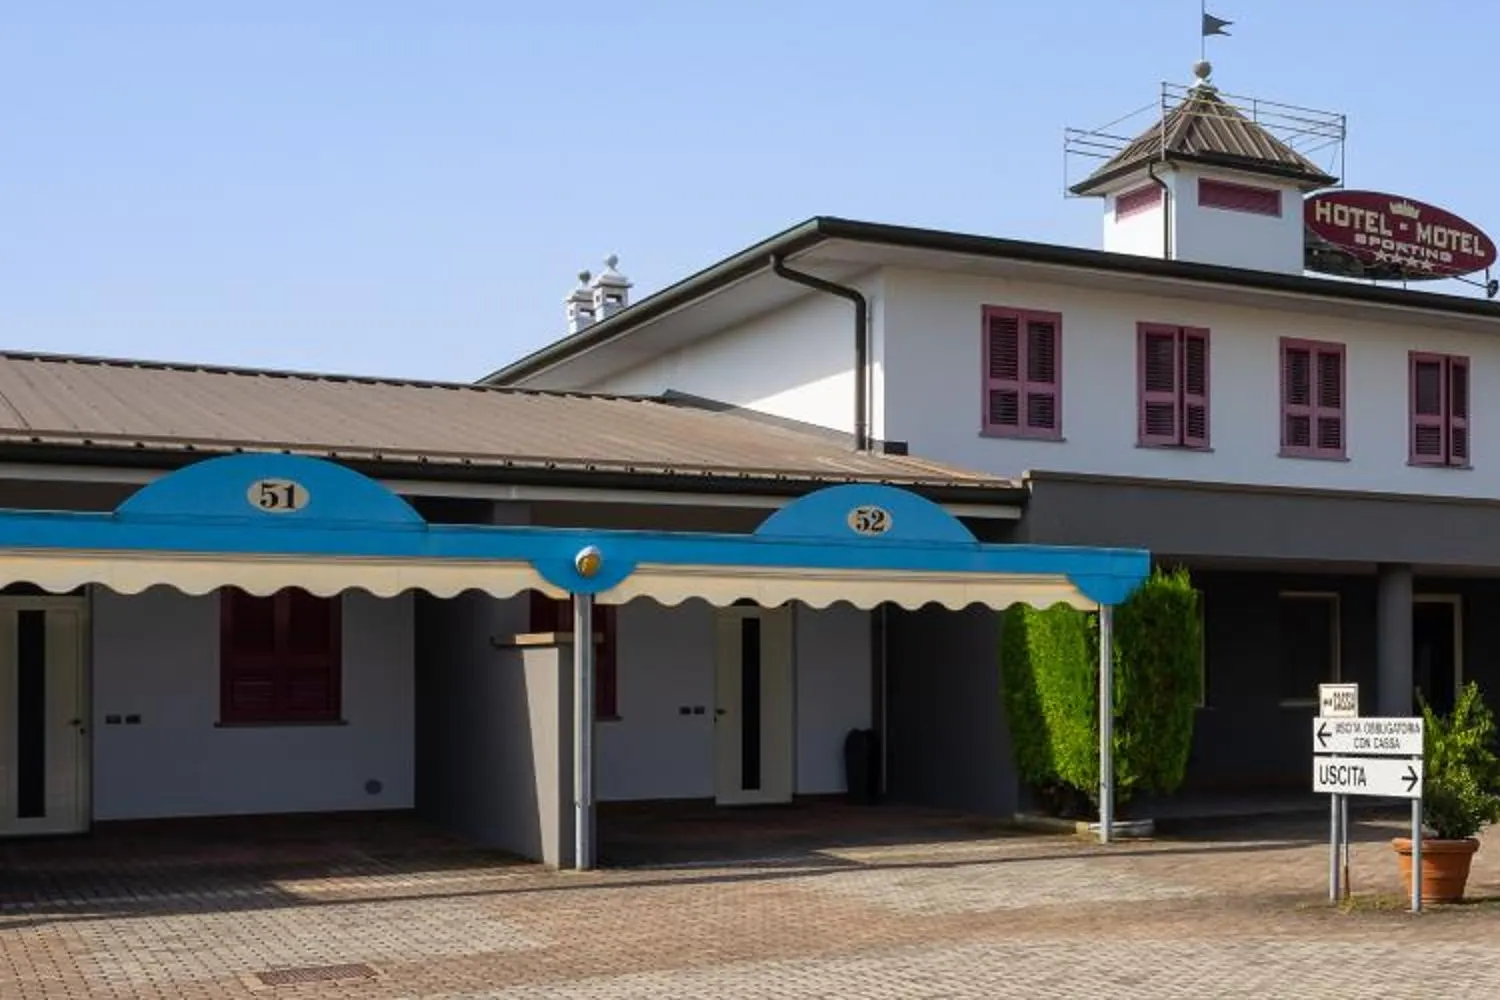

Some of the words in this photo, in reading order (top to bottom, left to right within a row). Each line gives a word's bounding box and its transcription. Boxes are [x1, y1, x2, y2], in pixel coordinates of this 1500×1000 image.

[1315, 200, 1392, 237] HOTEL
[1417, 222, 1484, 257] MOTEL
[260, 482, 295, 509] 51
[856, 509, 885, 532] 52
[1319, 765, 1366, 786] USCITA
